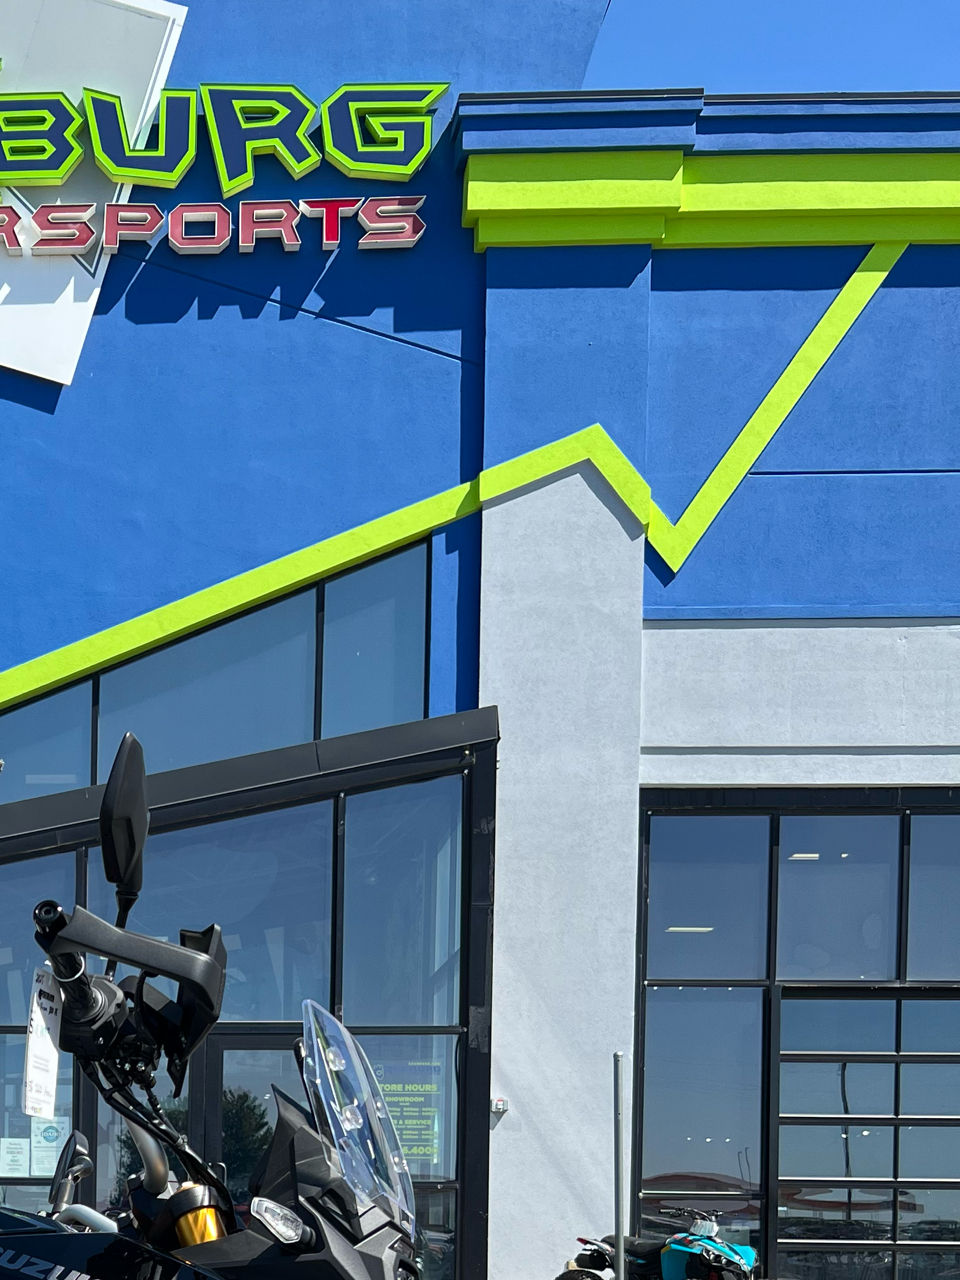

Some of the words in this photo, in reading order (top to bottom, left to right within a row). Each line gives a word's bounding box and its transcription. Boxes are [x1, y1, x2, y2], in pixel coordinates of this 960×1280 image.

[379, 1084, 403, 1092] TORE
[405, 1084, 438, 1092] HOURS
[402, 1146, 438, 1155] 6.4000
